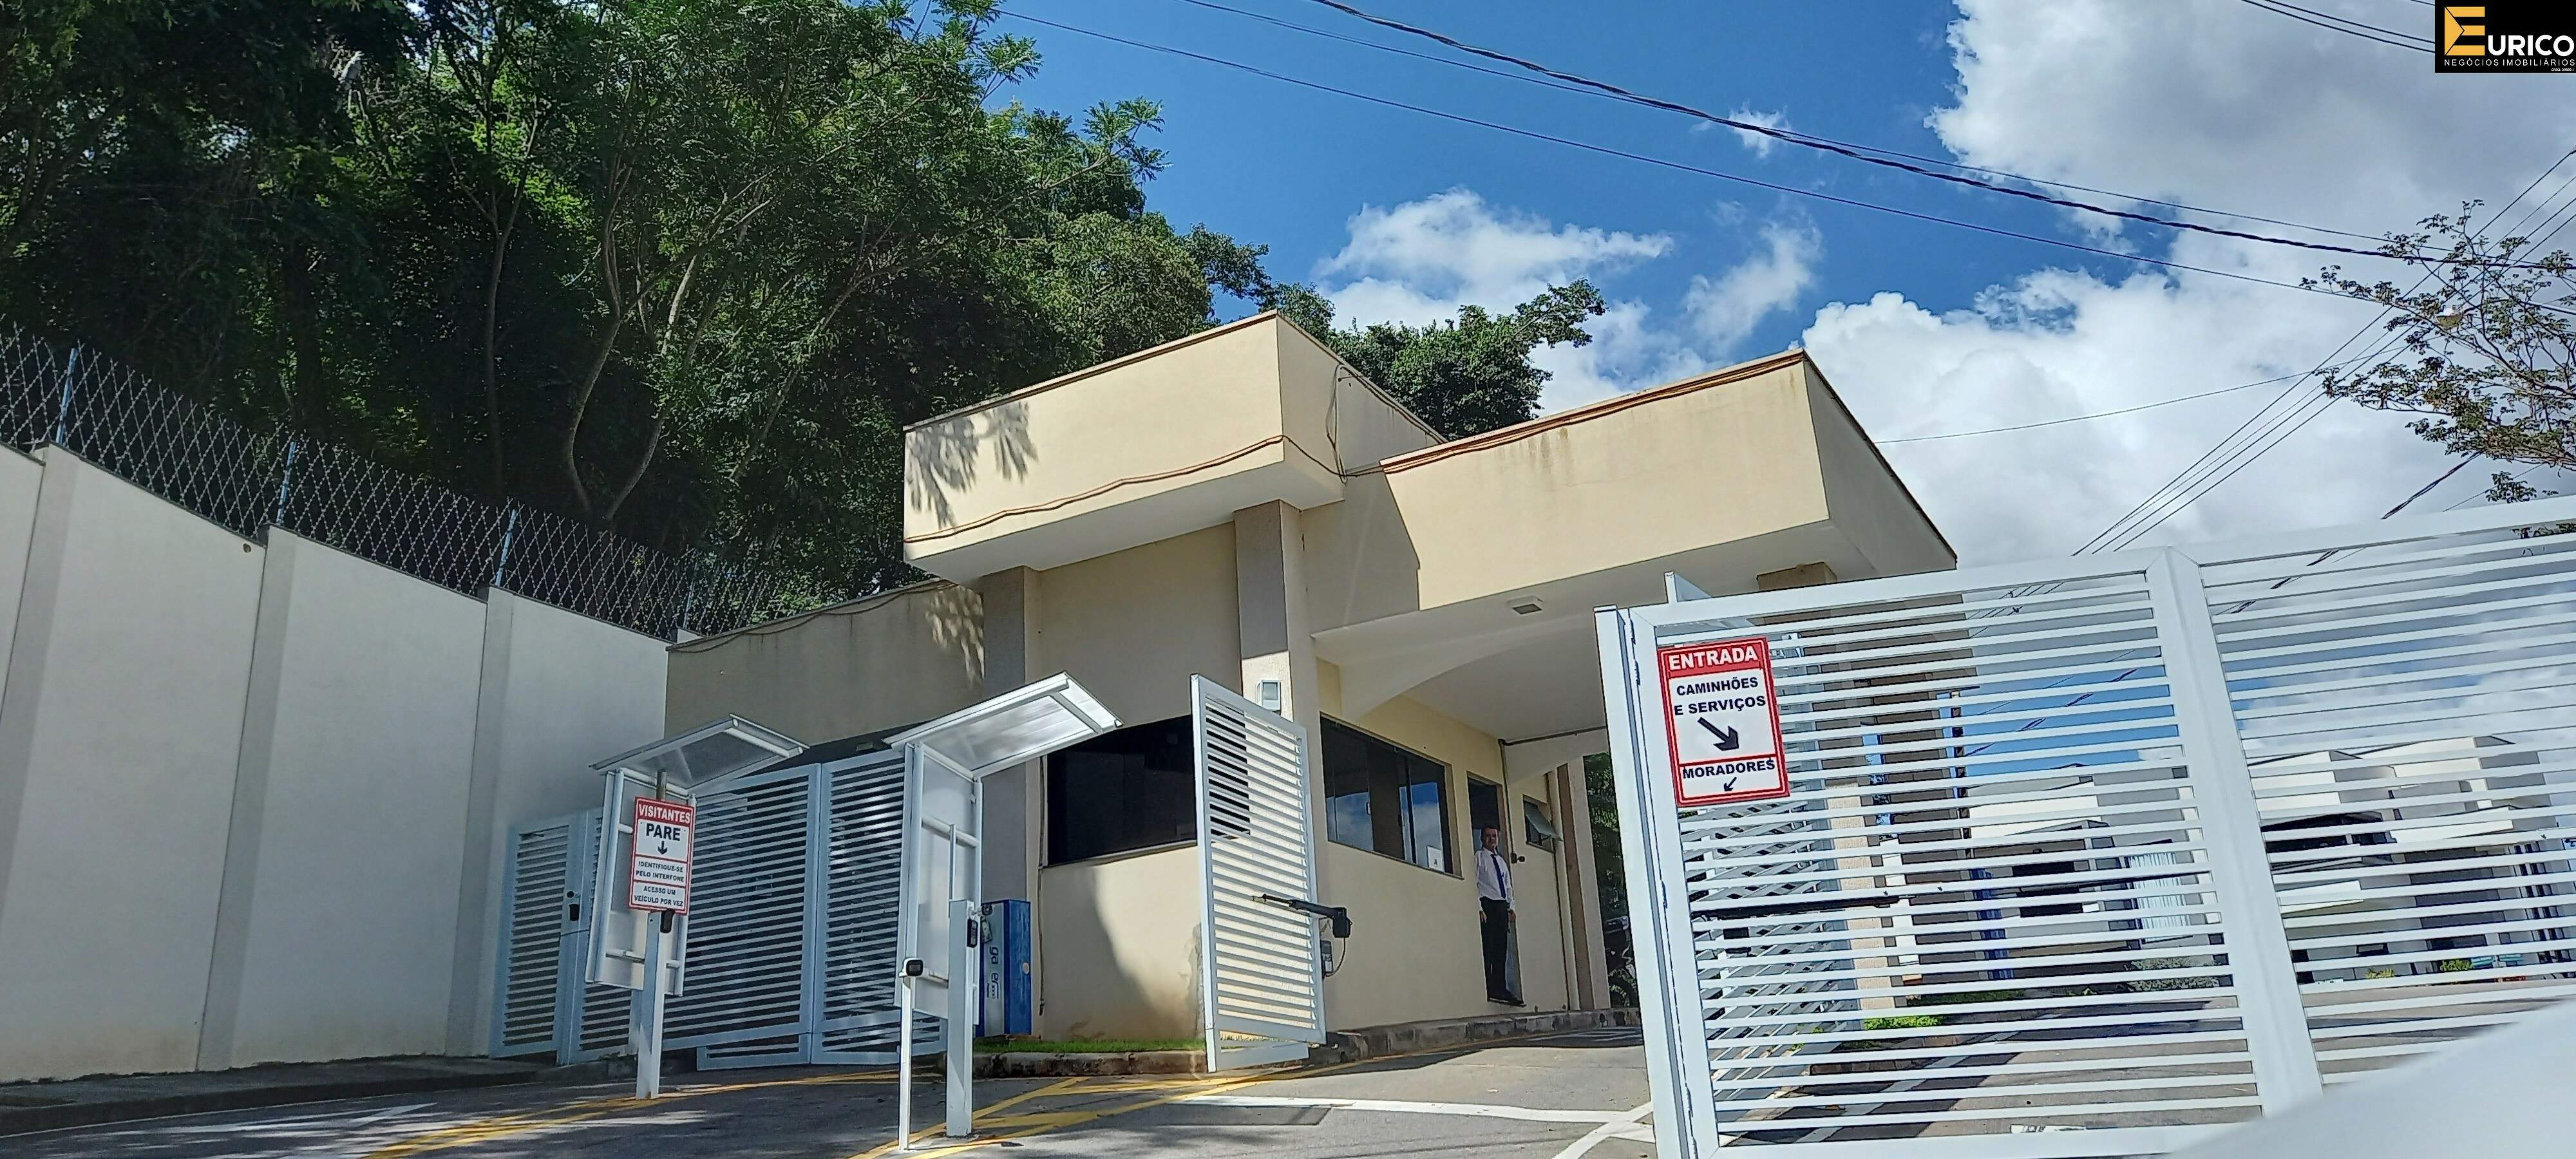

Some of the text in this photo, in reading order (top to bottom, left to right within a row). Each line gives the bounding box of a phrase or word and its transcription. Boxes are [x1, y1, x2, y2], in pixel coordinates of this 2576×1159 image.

[1668, 646, 1758, 671] ENTRADA
[1676, 677, 1758, 696] CAMINHÕES
[1674, 695, 1766, 715] E SERVIÇOS
[1682, 759, 1776, 779] MORADORES
[638, 804, 691, 824] VISITANTES
[646, 823, 681, 841] PARE
[638, 861, 683, 872] IDENTIFIQUE-SE
[652, 873, 685, 882] INTERFONE
[634, 894, 659, 903] VEÍCULO
[643, 885, 666, 894] ACESSO
